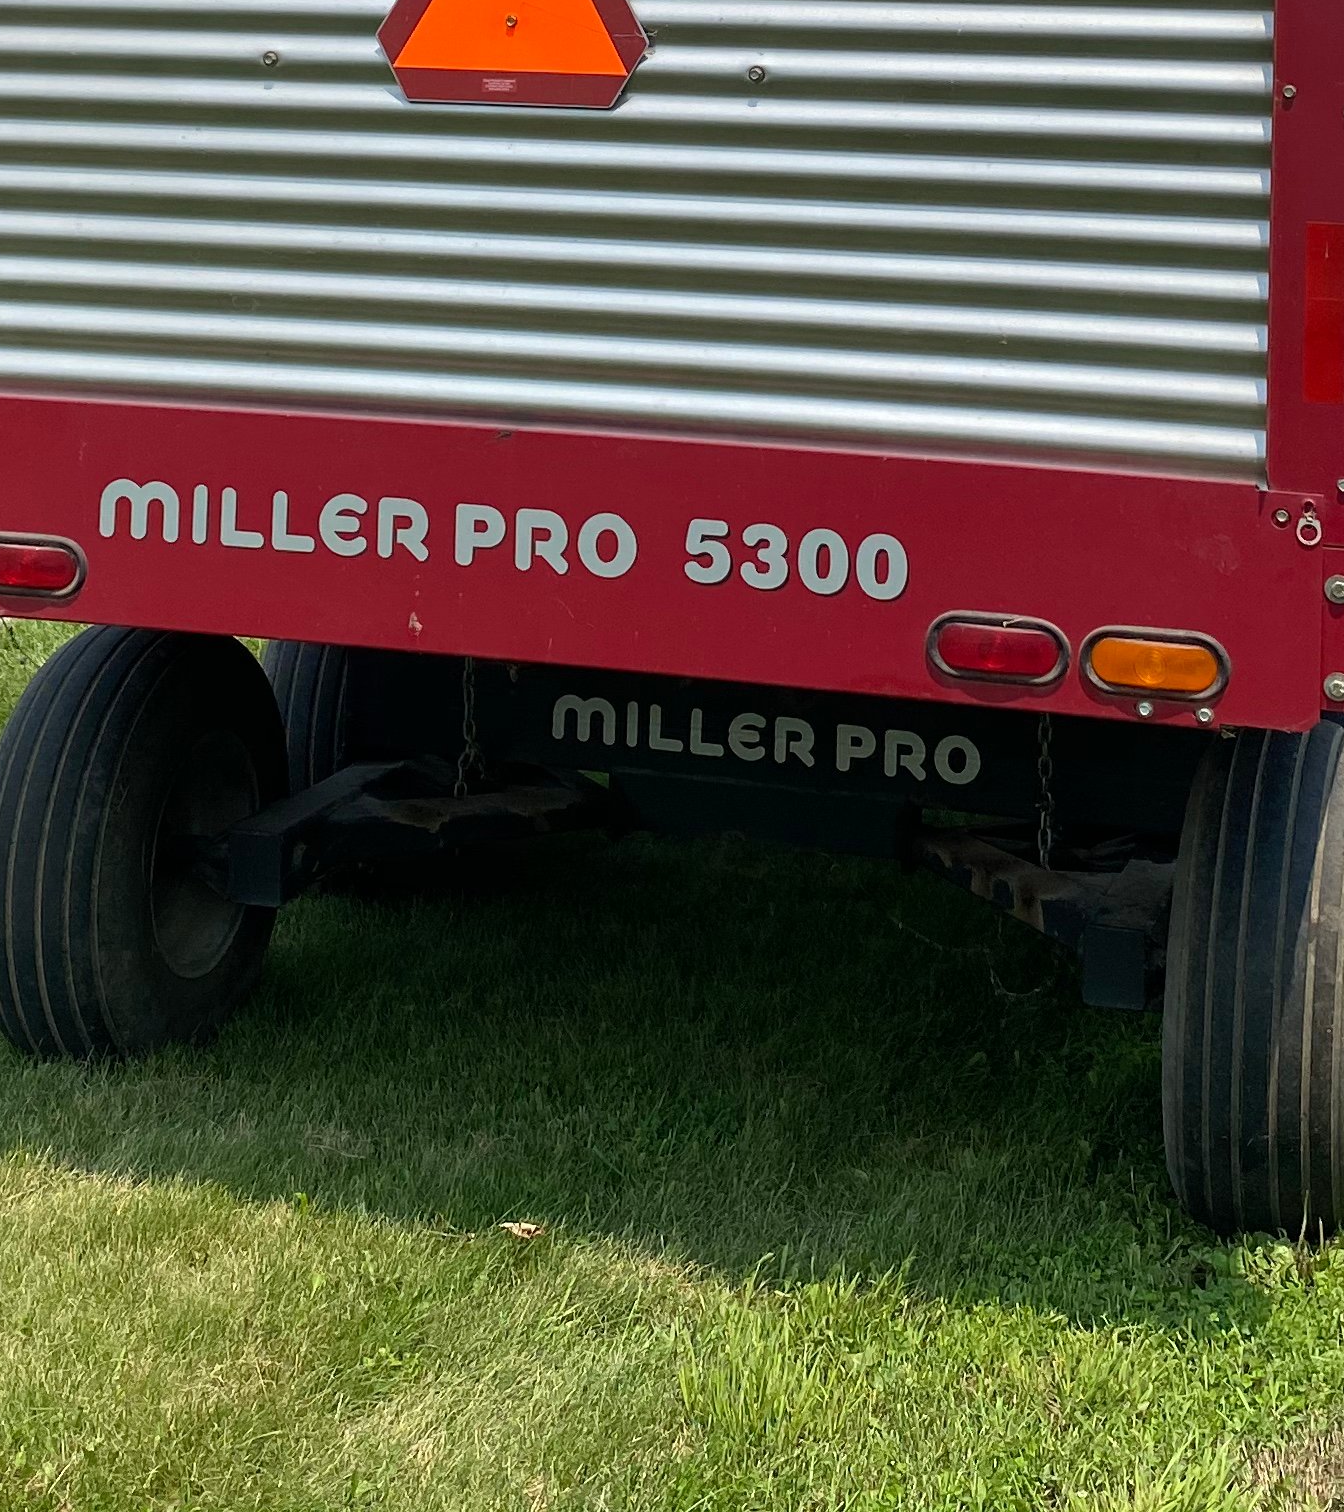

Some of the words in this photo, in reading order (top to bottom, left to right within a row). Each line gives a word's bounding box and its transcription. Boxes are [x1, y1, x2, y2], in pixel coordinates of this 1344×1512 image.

[99, 478, 429, 562] MILLER
[454, 503, 637, 578] PRO
[684, 518, 908, 600] 5300
[551, 694, 815, 768] MILLER
[835, 723, 981, 785] PRO
